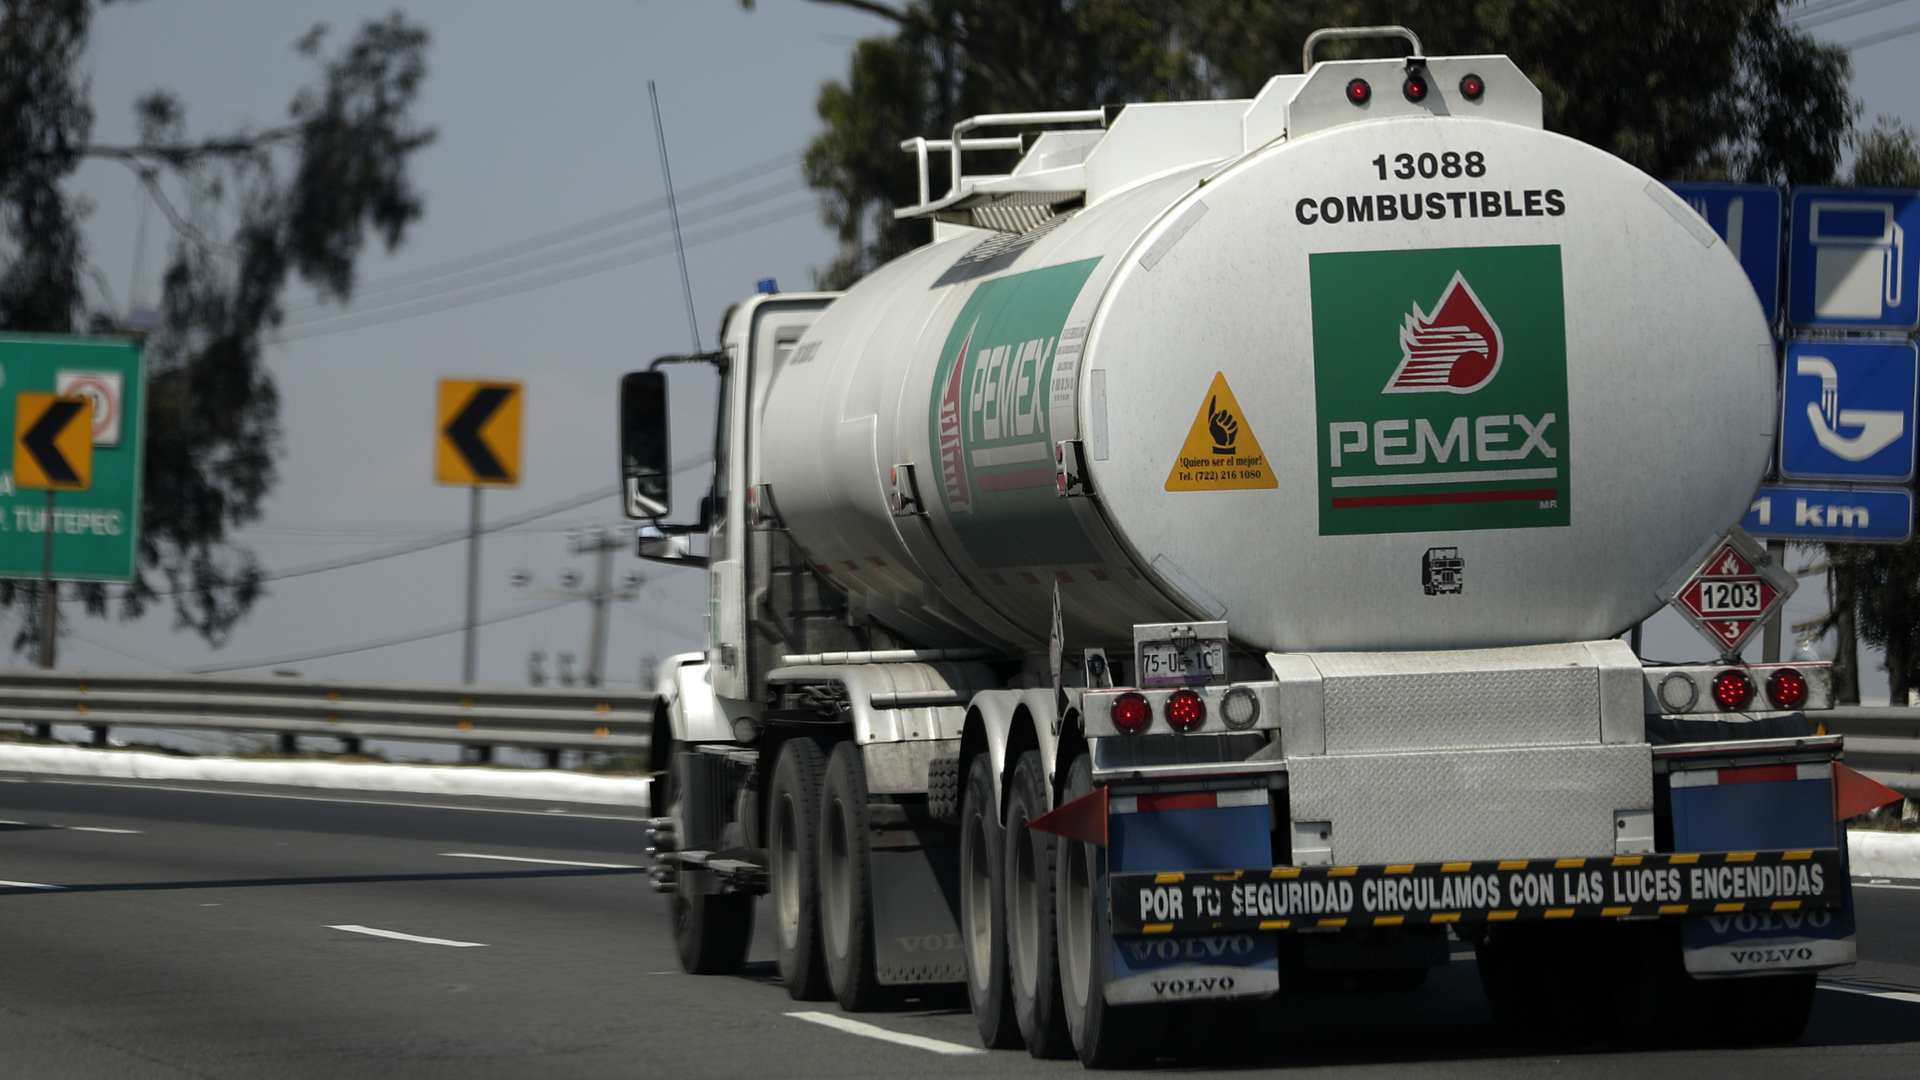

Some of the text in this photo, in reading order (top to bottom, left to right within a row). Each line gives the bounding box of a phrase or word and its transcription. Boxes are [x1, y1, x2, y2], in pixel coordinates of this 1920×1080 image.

[1372, 151, 1486, 180] 13088
[1295, 189, 1566, 225] COMBUSTIBLES
[969, 336, 1056, 443] PEMEX
[1329, 412, 1557, 468] PEMEX
[1212, 459, 1224, 467] ser
[1226, 456, 1234, 466] el
[1236, 455, 1262, 468] mejor!
[1179, 470, 1261, 482] Tel. (722) 216 1080
[1539, 500, 1557, 509] MR
[1751, 496, 1869, 529] 1 km
[1703, 583, 1758, 609] 1203
[1724, 621, 1740, 639] 3
[1143, 651, 1212, 673] 75-U1C
[1140, 863, 1825, 921] POR TU SEGURIDAD CIRCULAMOS CON LAS LUCES ENCENDIDAS
[1703, 909, 1831, 934] VOLVO
[895, 933, 964, 952] VOL
[1126, 934, 1254, 962] VOLVO
[1730, 948, 1813, 964] VOLVO
[1151, 976, 1235, 995] VOLVO
